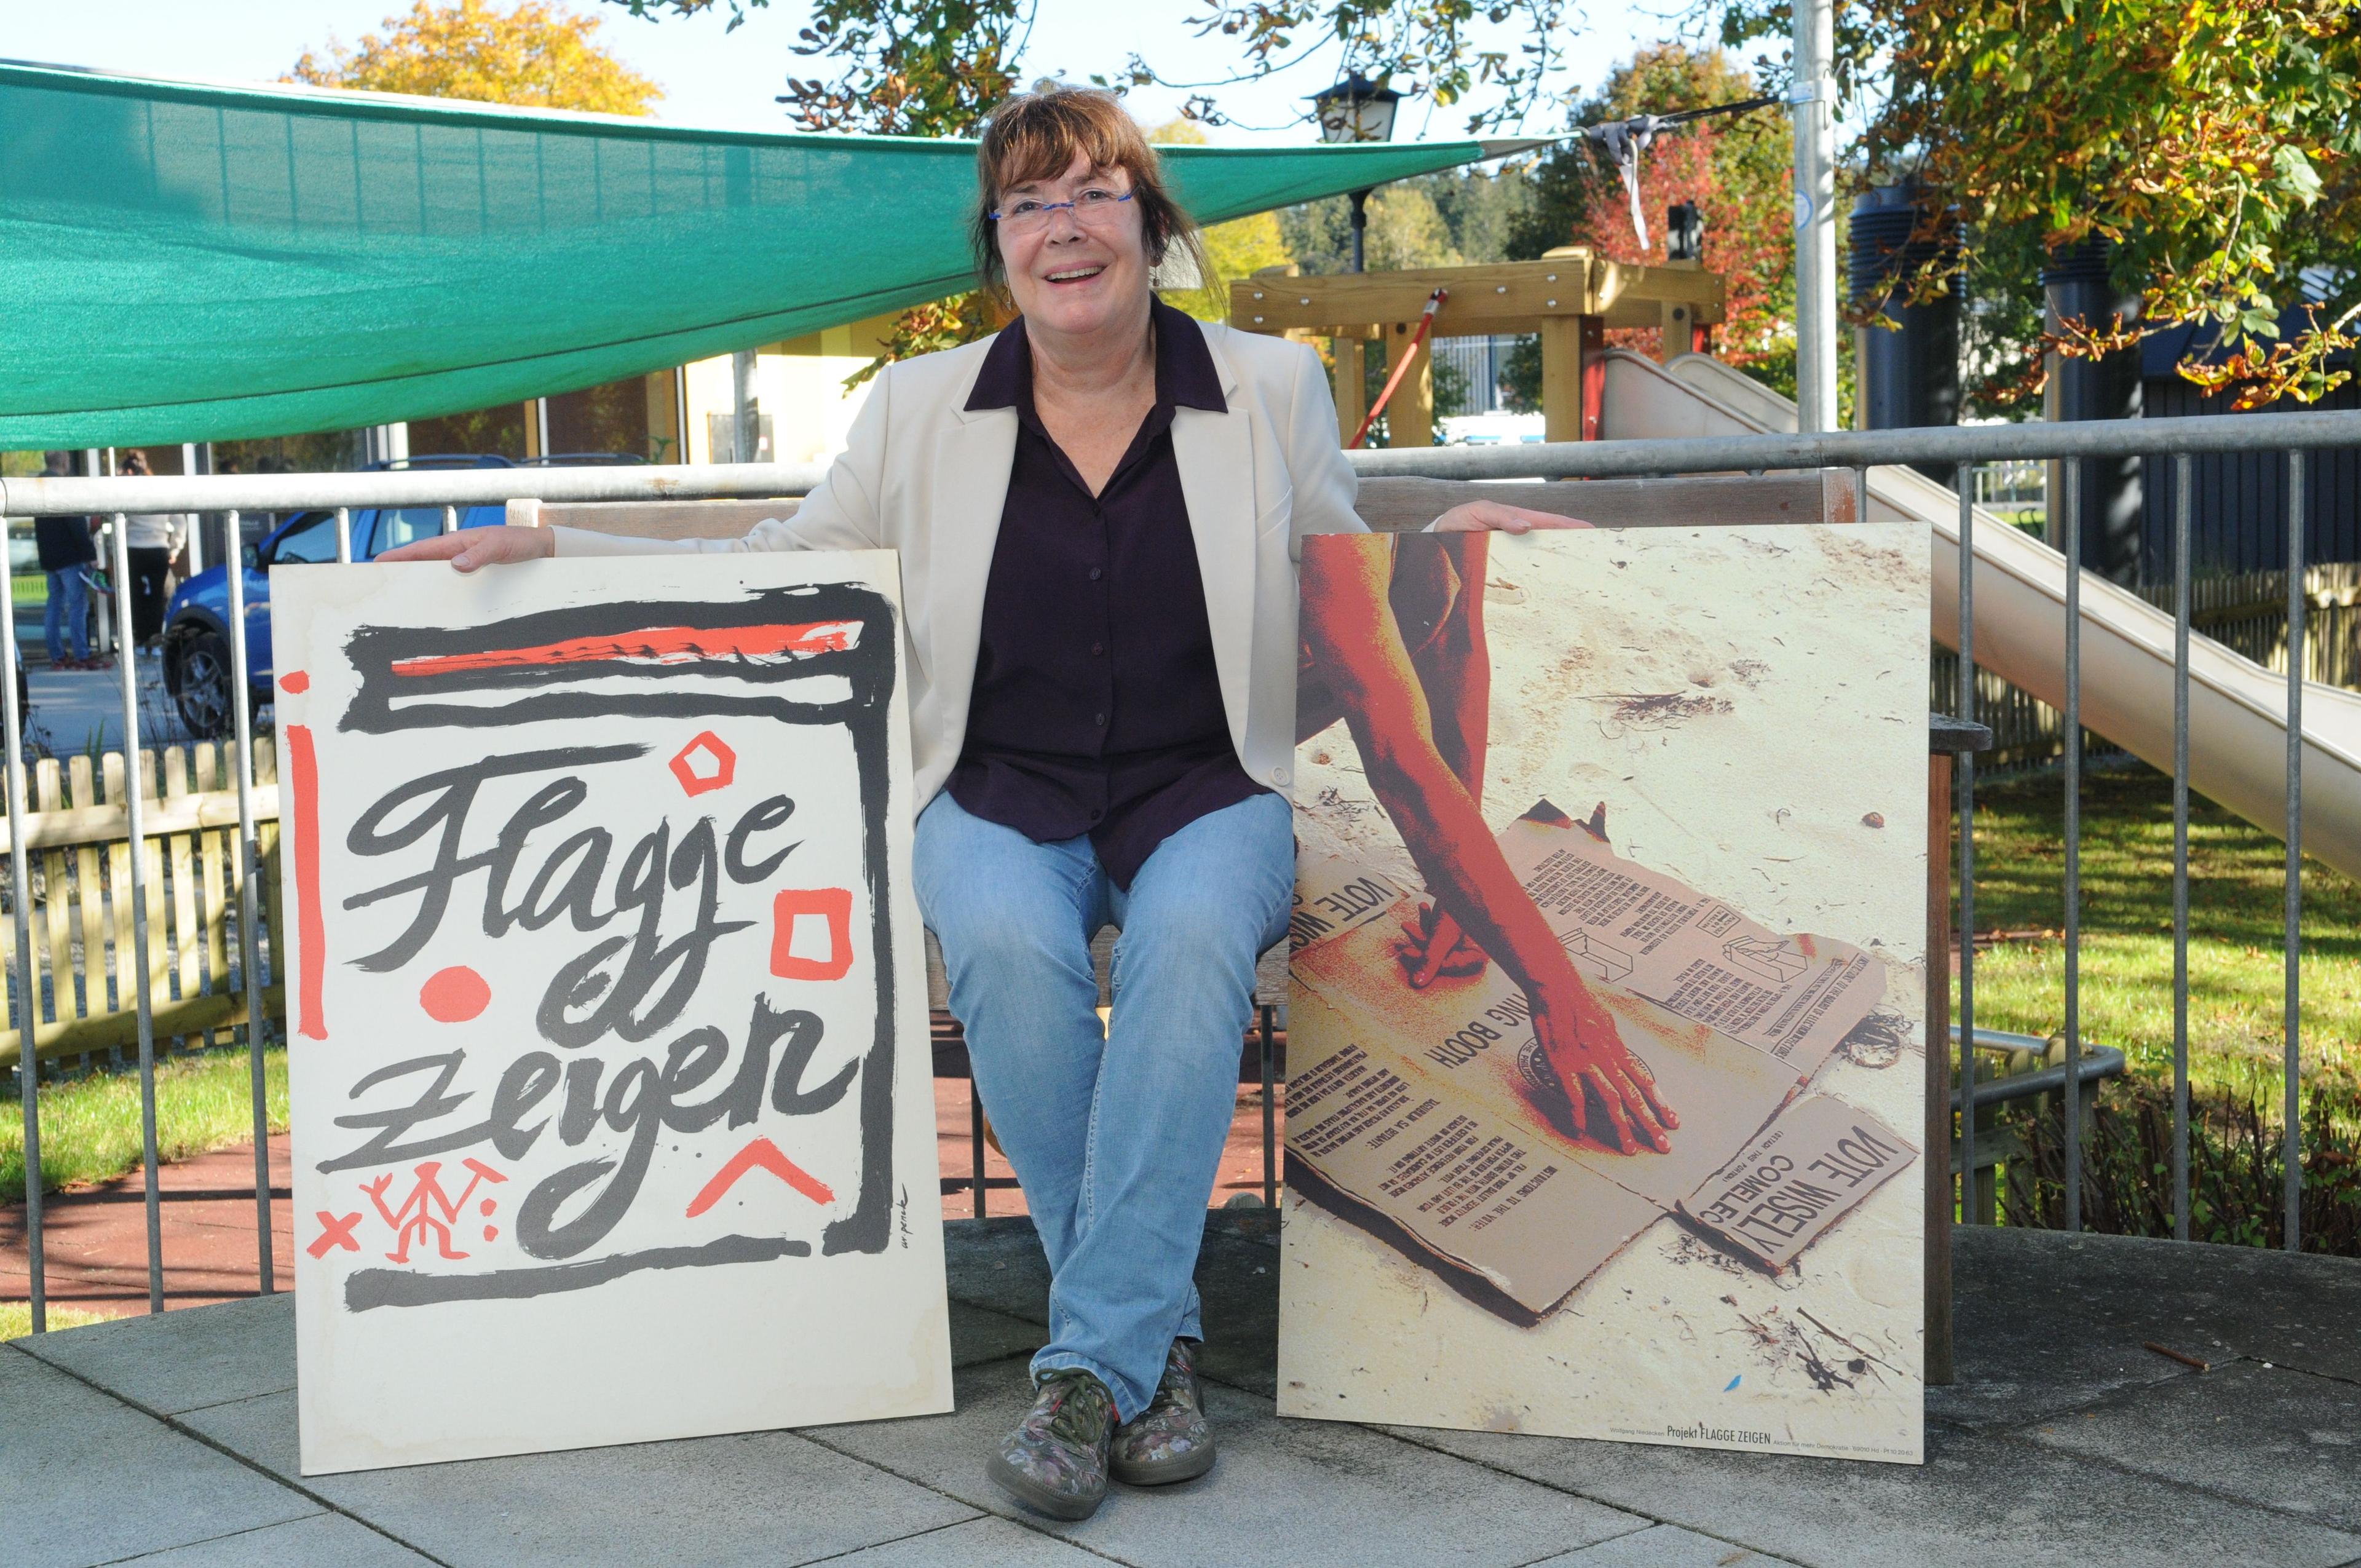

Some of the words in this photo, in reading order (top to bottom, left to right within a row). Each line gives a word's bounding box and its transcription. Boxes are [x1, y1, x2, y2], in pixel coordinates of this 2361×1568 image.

[342, 743, 805, 1048] Flagge
[1312, 876, 1395, 922] VOTE
[1422, 1020, 1504, 1070] BOOTH
[1806, 1125, 1899, 1189] VOTE
[1490, 1202, 1511, 1216] THE
[1505, 1194, 1521, 1206] TO
[1697, 1155, 1798, 1227] COMELEC
[1730, 1178, 1843, 1255] WISELY
[1667, 1425, 1698, 1441] Projekt
[1701, 1427, 1736, 1441] FLAGGE
[1738, 1430, 1771, 1444] ZEIGEN
